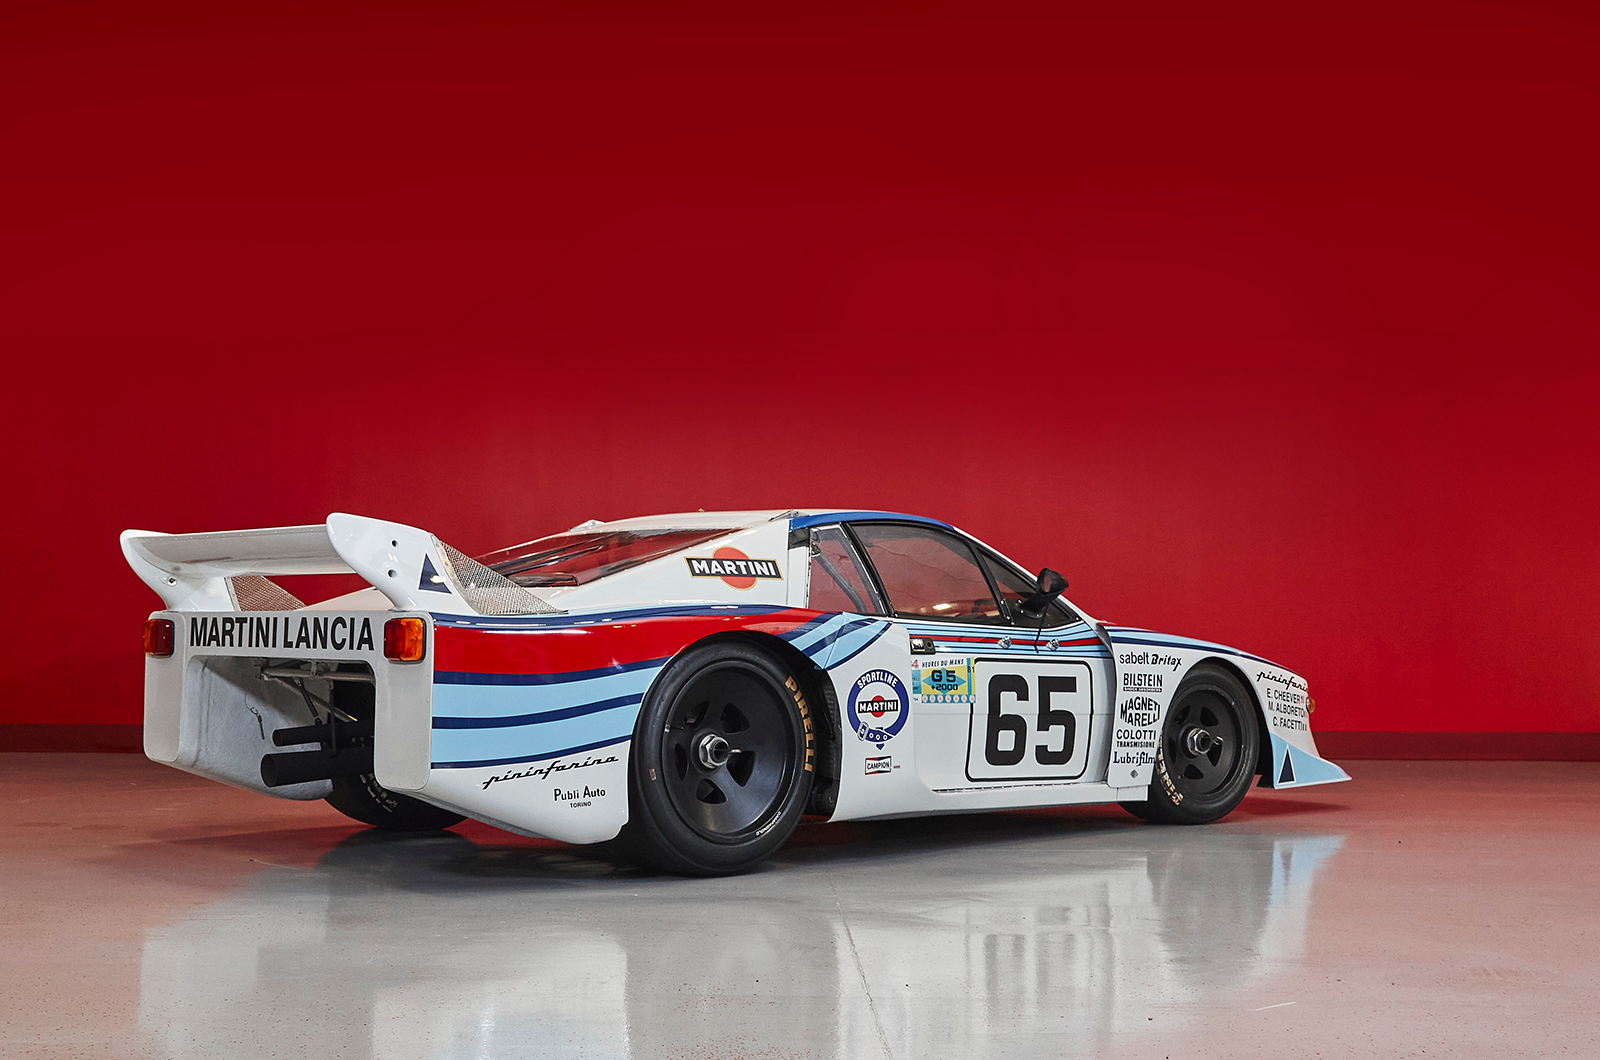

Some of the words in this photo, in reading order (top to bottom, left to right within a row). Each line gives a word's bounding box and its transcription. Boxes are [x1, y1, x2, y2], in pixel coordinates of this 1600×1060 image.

[691, 560, 777, 576] MARTINI
[190, 617, 278, 648] MARTINI
[284, 616, 375, 651] LANCIA
[911, 659, 919, 668] 4
[949, 658, 965, 666] MANS
[1119, 651, 1150, 665] sabelt
[1151, 653, 1182, 672] Britax
[857, 671, 898, 689] SPORTLINE
[1123, 673, 1163, 687] BILSTEIN
[1273, 690, 1301, 704] CHEEVER
[859, 701, 897, 712] MARTINI
[1120, 696, 1161, 723] MAGNETI
[1120, 702, 1161, 727] MARELLI
[785, 675, 816, 772] PIRELLI
[985, 674, 1077, 766] 65
[1116, 729, 1157, 740] COLOTTI
[1112, 751, 1155, 767] Lubrifilm
[482, 756, 619, 790] pininfarina
[553, 788, 580, 802] Publi
[582, 785, 607, 799] Auto
